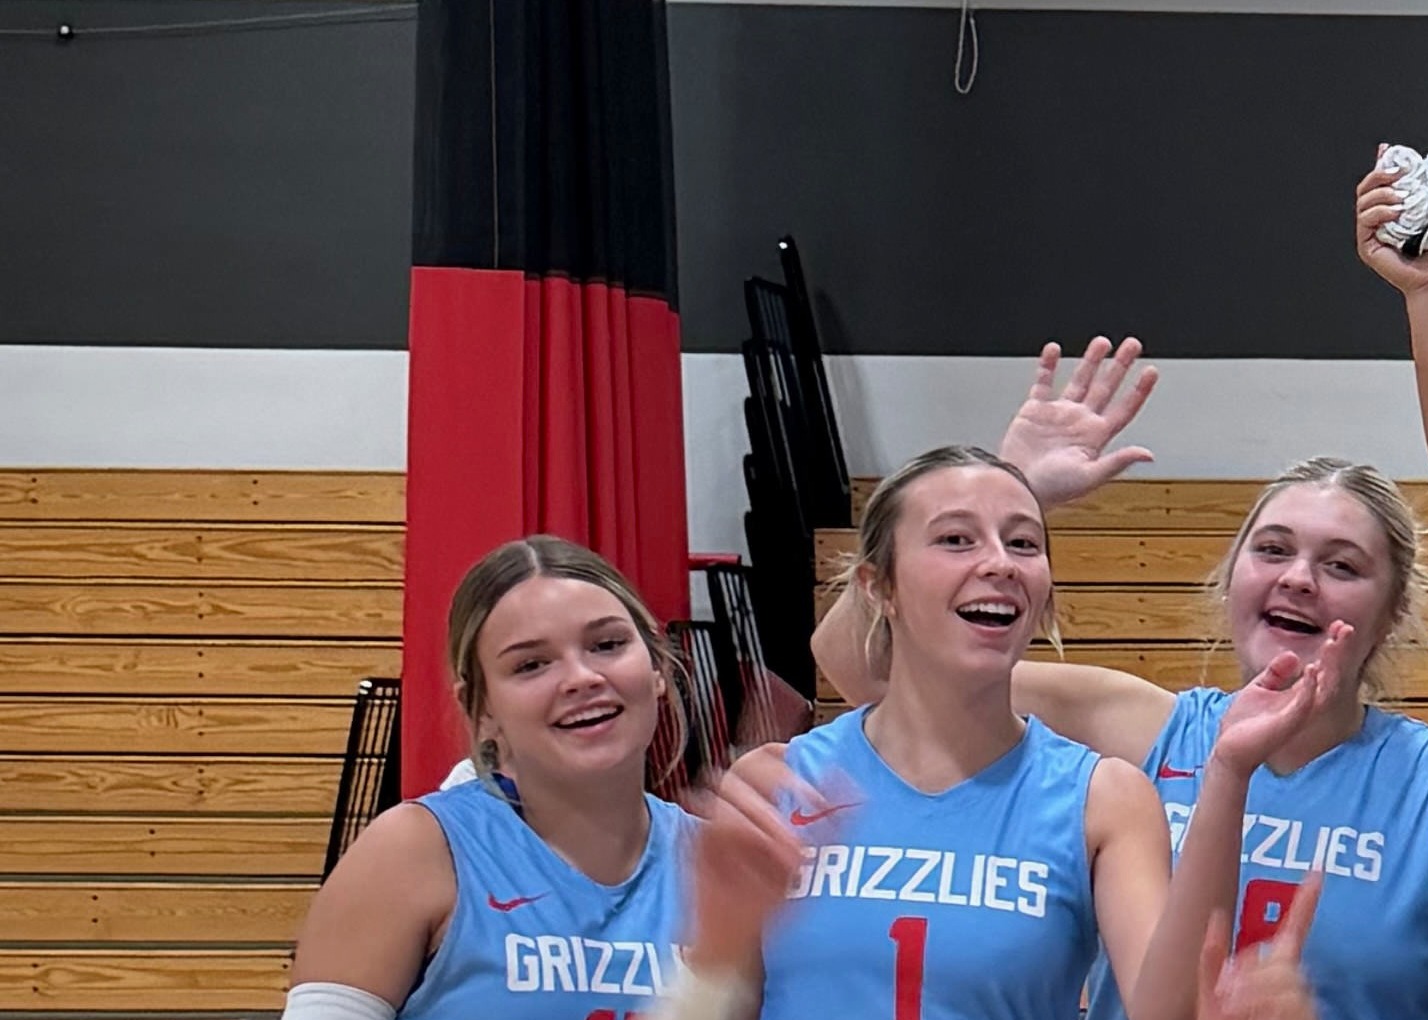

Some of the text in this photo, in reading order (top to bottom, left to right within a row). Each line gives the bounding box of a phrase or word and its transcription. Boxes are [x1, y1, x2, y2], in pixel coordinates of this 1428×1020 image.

[1165, 802, 1385, 882] GZZLIES
[786, 845, 1049, 917] GRIZZLIES
[506, 932, 681, 996] GRIZZL
